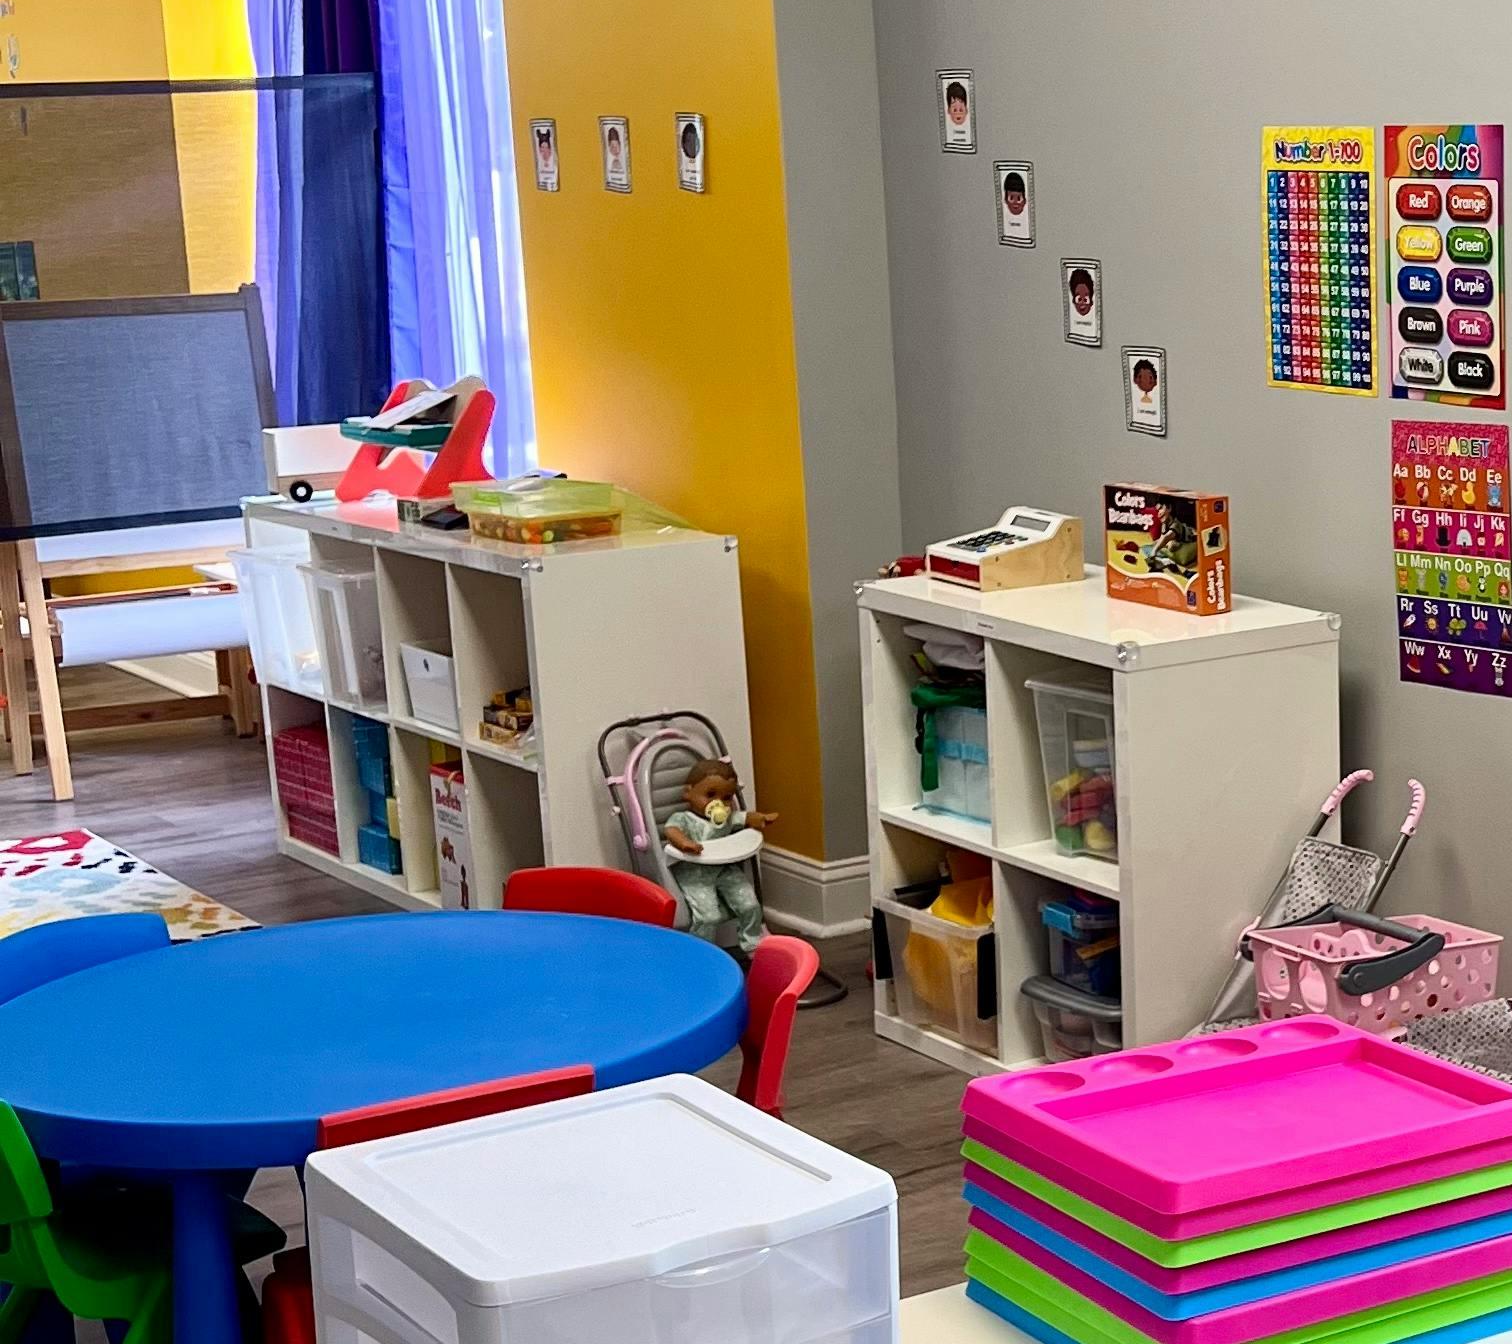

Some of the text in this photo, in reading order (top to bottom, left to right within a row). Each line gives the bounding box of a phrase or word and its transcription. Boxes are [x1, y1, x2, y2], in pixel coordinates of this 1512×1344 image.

[1275, 138, 1326, 162] Number
[1407, 134, 1480, 171] Colors
[1409, 193, 1429, 209] Red
[1451, 195, 1487, 213] Orange
[1455, 238, 1483, 251] Green
[1409, 277, 1431, 291] Blue
[1455, 278, 1485, 295] Purple
[1407, 317, 1436, 331] Brown
[1459, 320, 1481, 335] Pink
[1408, 358, 1433, 373] White
[1458, 363, 1483, 377] Black
[1406, 433, 1492, 458] ALPHABET
[1393, 463, 1502, 483] Aa Bb Cc Dd Ee
[1114, 491, 1146, 508] Colors
[1412, 510, 1505, 532] Gg Hh Jj Kk
[1411, 555, 1510, 578] Mm Nn Oo Pp Qq
[1206, 569, 1216, 604] Colors
[1401, 598, 1512, 624] Rr Ss Tt Uu Vv
[1404, 641, 1507, 668] Ww Xx Yy Zz
